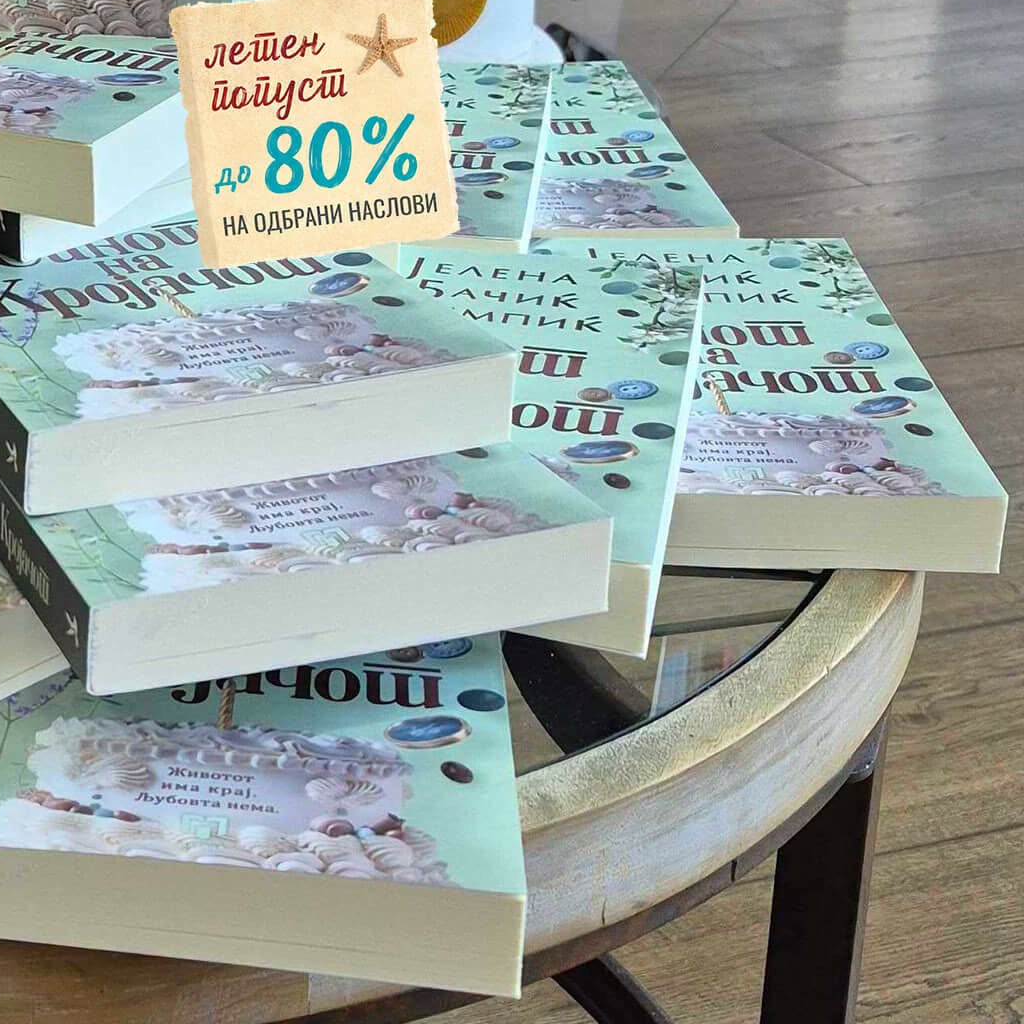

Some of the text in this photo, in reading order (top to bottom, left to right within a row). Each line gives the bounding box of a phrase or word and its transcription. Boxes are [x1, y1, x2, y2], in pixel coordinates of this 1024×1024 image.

[93, 254, 173, 276] на
[167, 764, 256, 783] Животот
[161, 781, 257, 800] има крај.
[135, 792, 280, 816] Љубовта нема.
